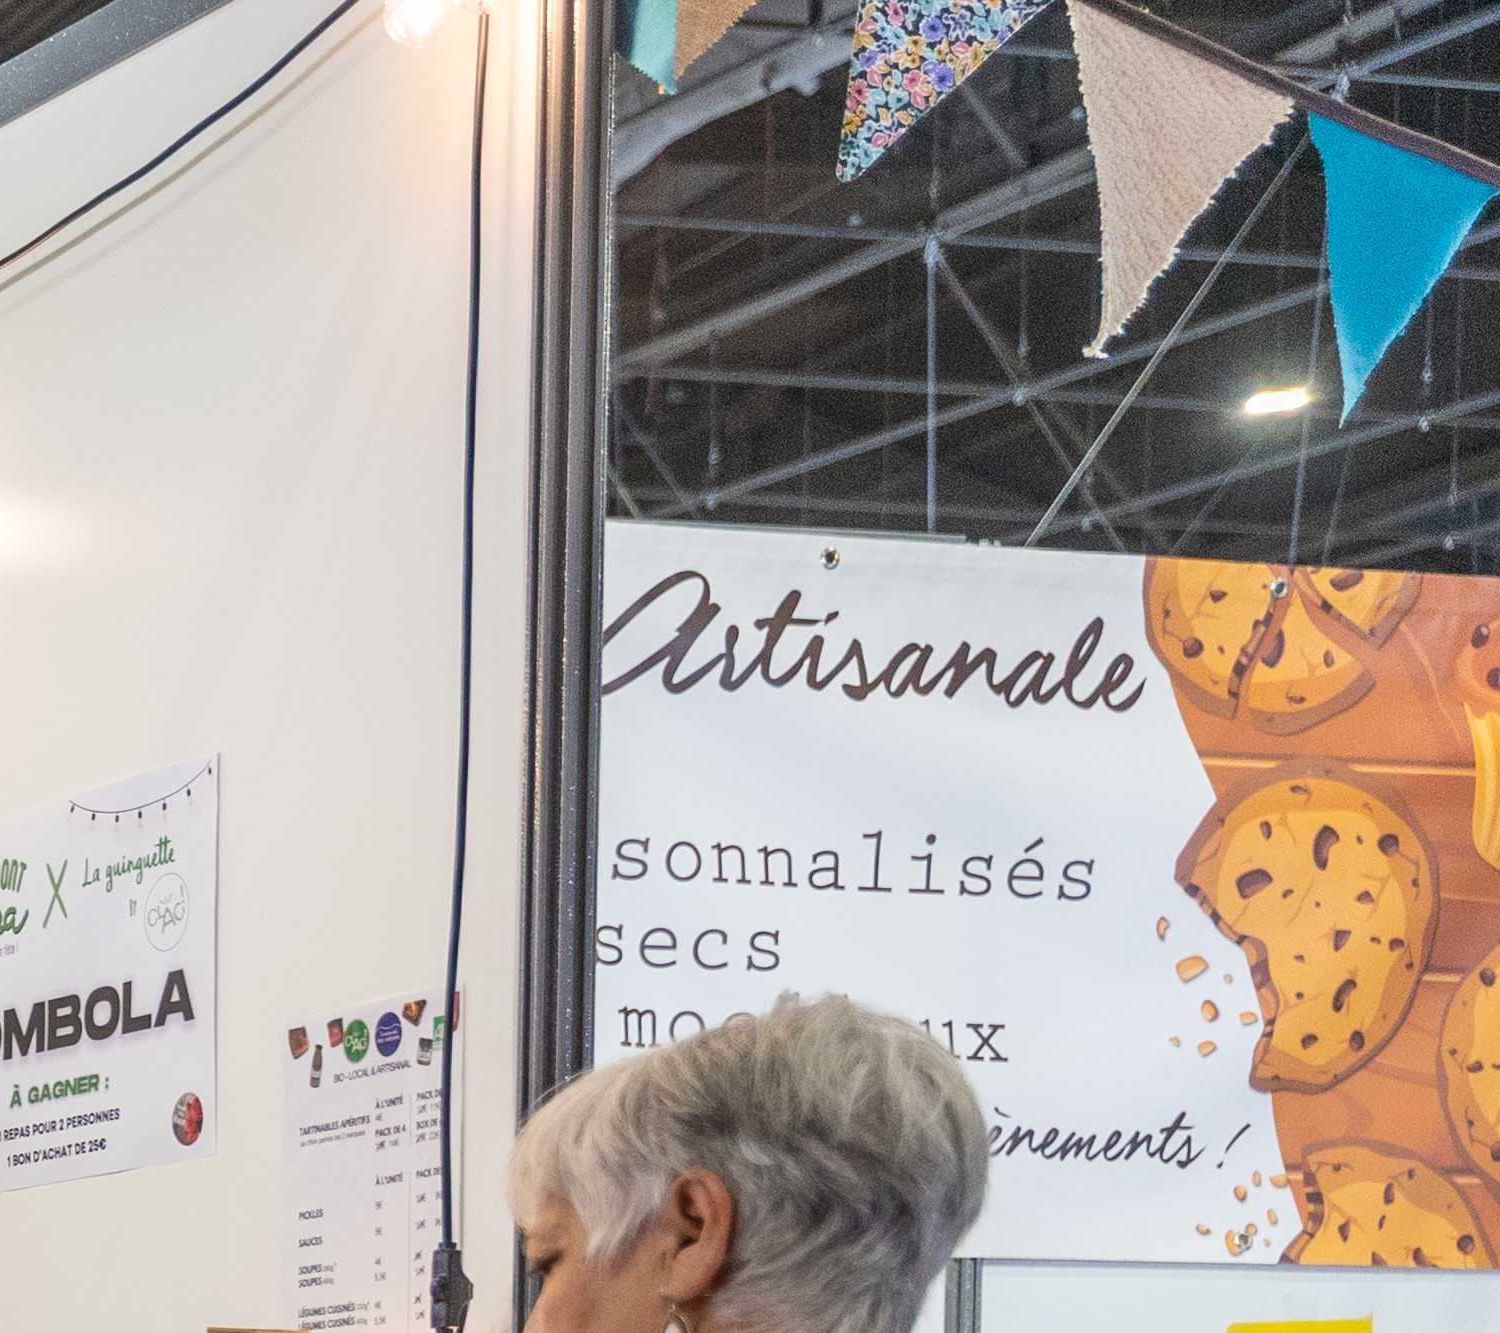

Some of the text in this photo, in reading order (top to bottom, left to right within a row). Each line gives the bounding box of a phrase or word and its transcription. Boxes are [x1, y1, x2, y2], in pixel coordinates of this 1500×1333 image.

[600, 569, 1148, 713] Artisanale
[82, 835, 176, 893] La guinguette
[609, 829, 1096, 903] sonnalisés
[147, 885, 186, 935] CLAC!
[10, 1084, 22, 1110] À
[28, 1074, 100, 1105] GAGNER
[3, 1125, 31, 1141] REPAS
[32, 1121, 57, 1138] POUR
[58, 1118, 65, 1132] 2
[66, 1108, 120, 1131] PERSONNES
[13, 1151, 31, 1168] BON
[32, 1145, 73, 1164] D'ACHAT
[74, 1142, 87, 1157] DE
[88, 1138, 107, 1154] 25€
